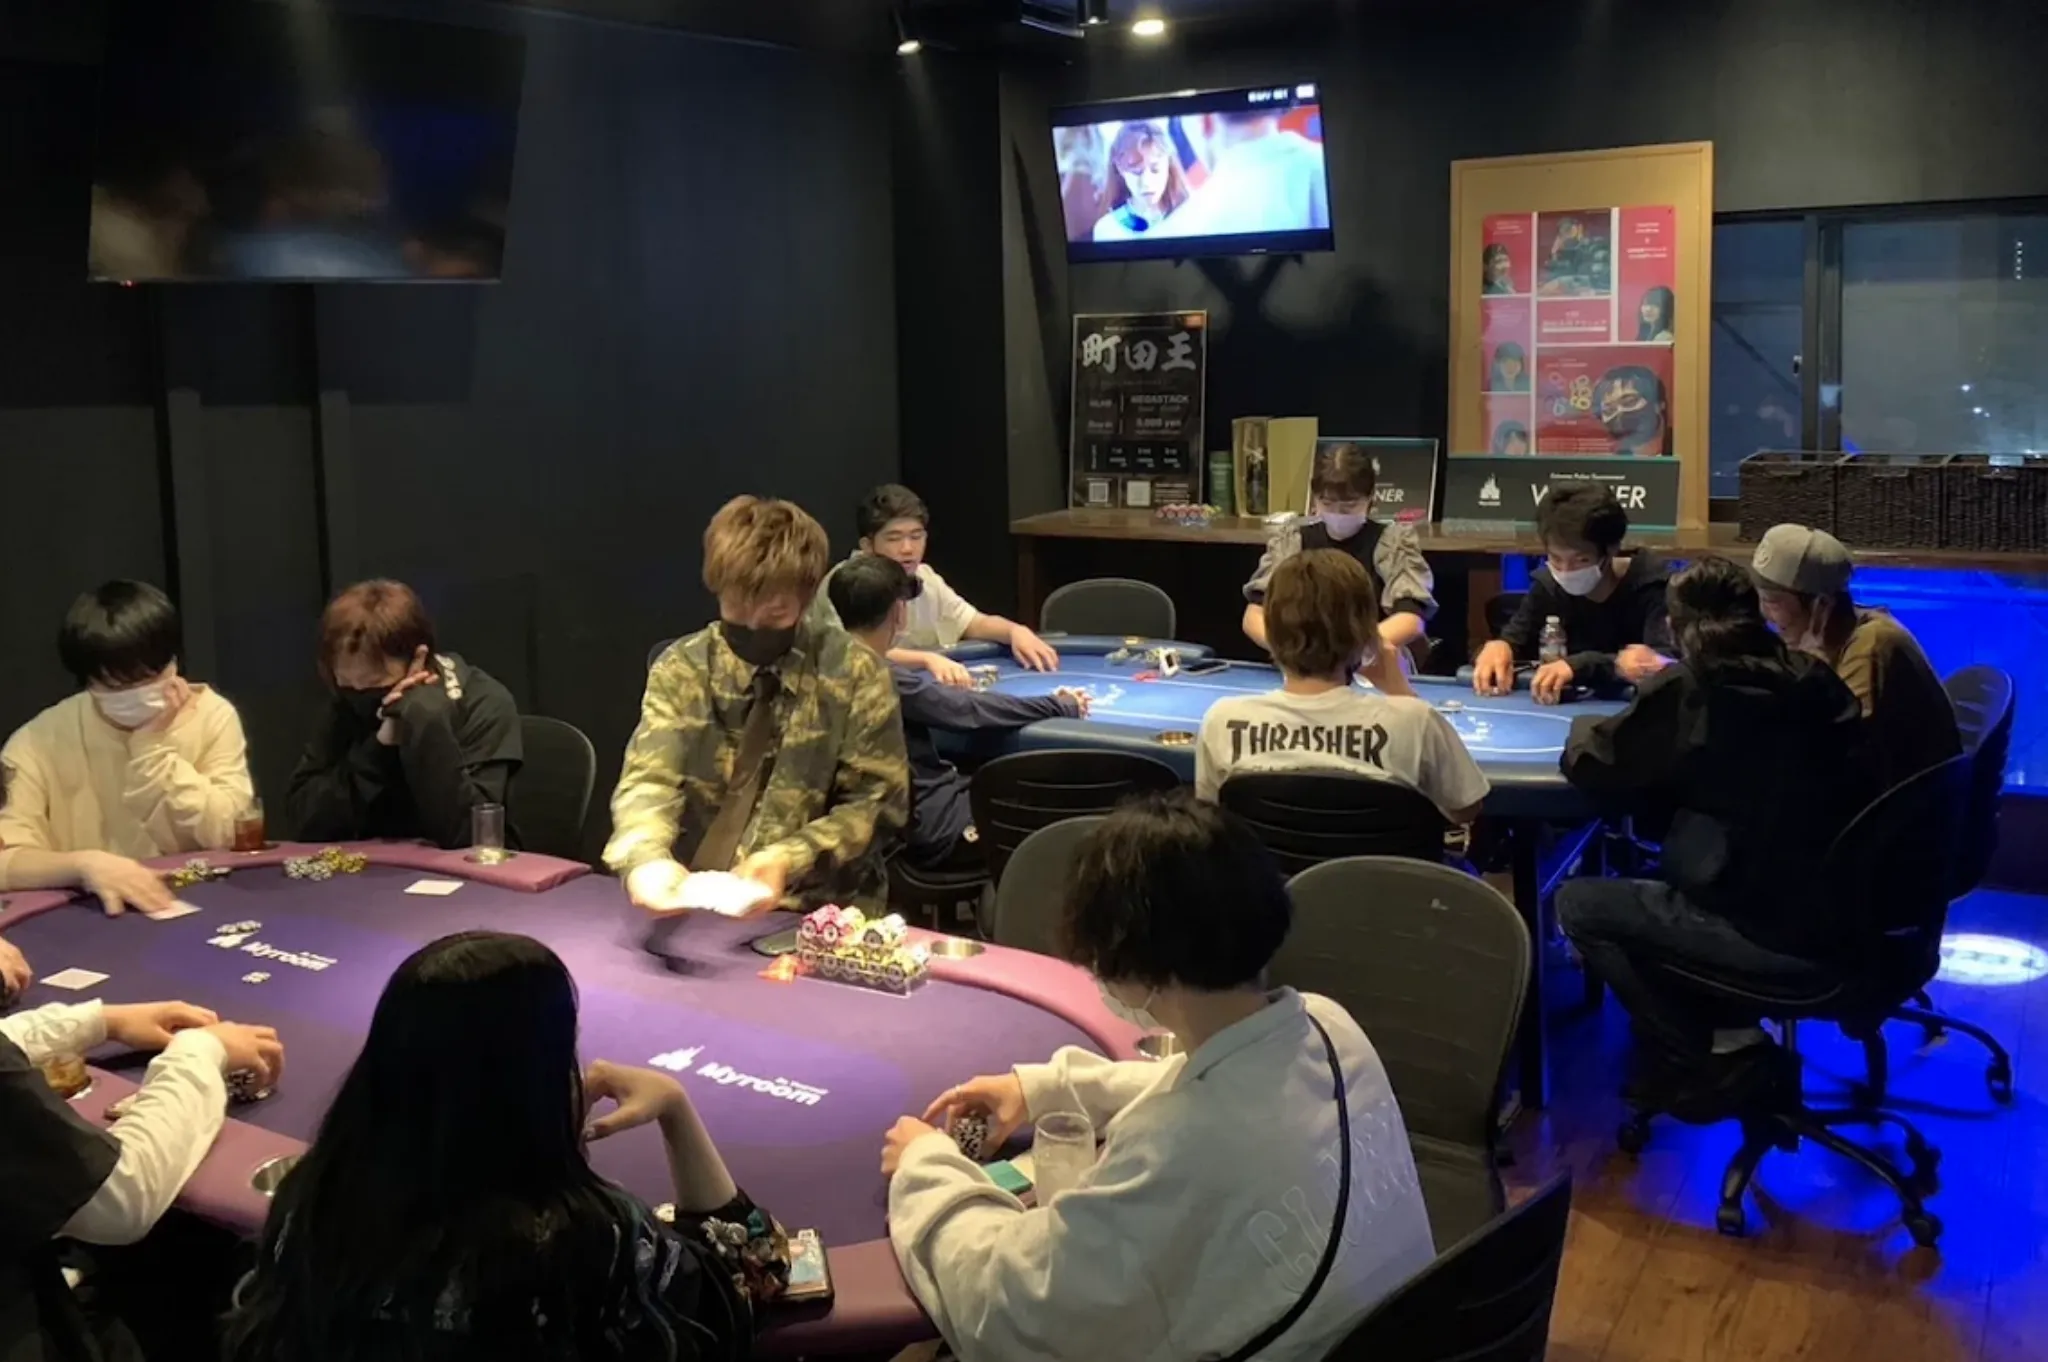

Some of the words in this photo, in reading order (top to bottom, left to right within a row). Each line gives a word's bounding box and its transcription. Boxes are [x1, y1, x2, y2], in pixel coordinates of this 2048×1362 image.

[1082, 331, 1196, 373] 町田王
[1226, 719, 1388, 769] THRASHER
[696, 1061, 822, 1106] Myroom
